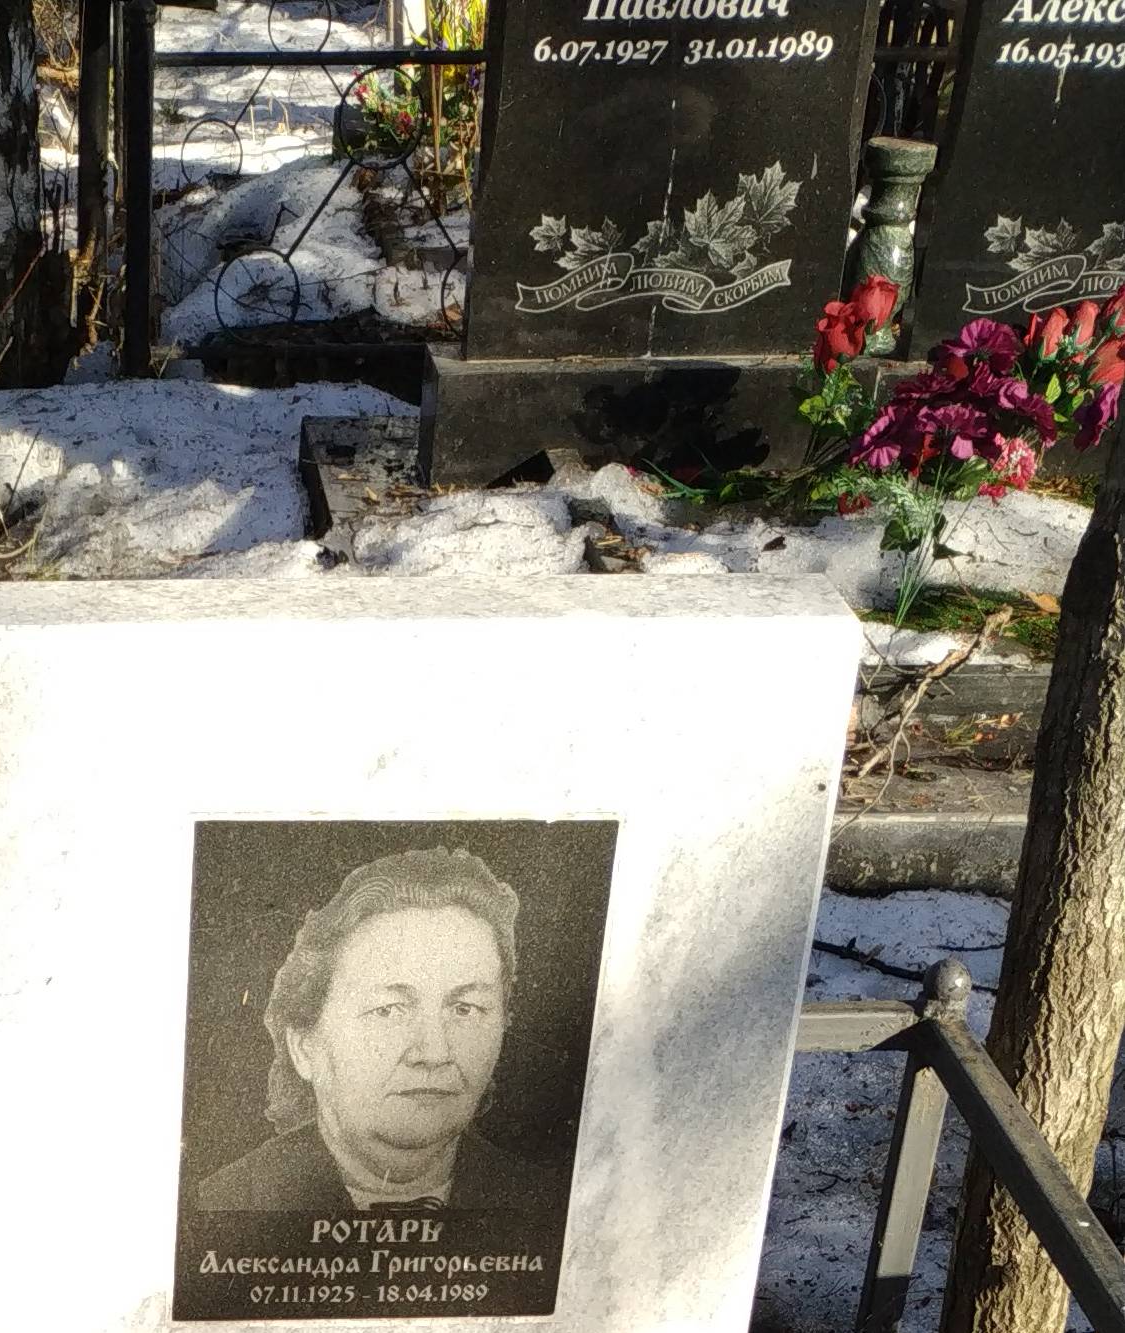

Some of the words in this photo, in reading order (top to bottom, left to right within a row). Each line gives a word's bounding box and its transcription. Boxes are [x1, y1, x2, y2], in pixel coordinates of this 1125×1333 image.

[583, 0, 790, 20] Павлович
[533, 36, 669, 65] 6.07.1927
[683, 30, 834, 64] 31.01.1989
[535, 262, 618, 304] ПОМНИМ
[629, 272, 706, 298] ЛЮБИМ
[714, 269, 783, 306] СКОРБИМ
[983, 263, 1069, 304] ПОМНИМ
[199, 1250, 361, 1280] Александра
[371, 1250, 544, 1279] Григорьевна
[249, 1285, 355, 1304] 07.11.1925
[376, 1283, 490, 1302] 18.04.1989
